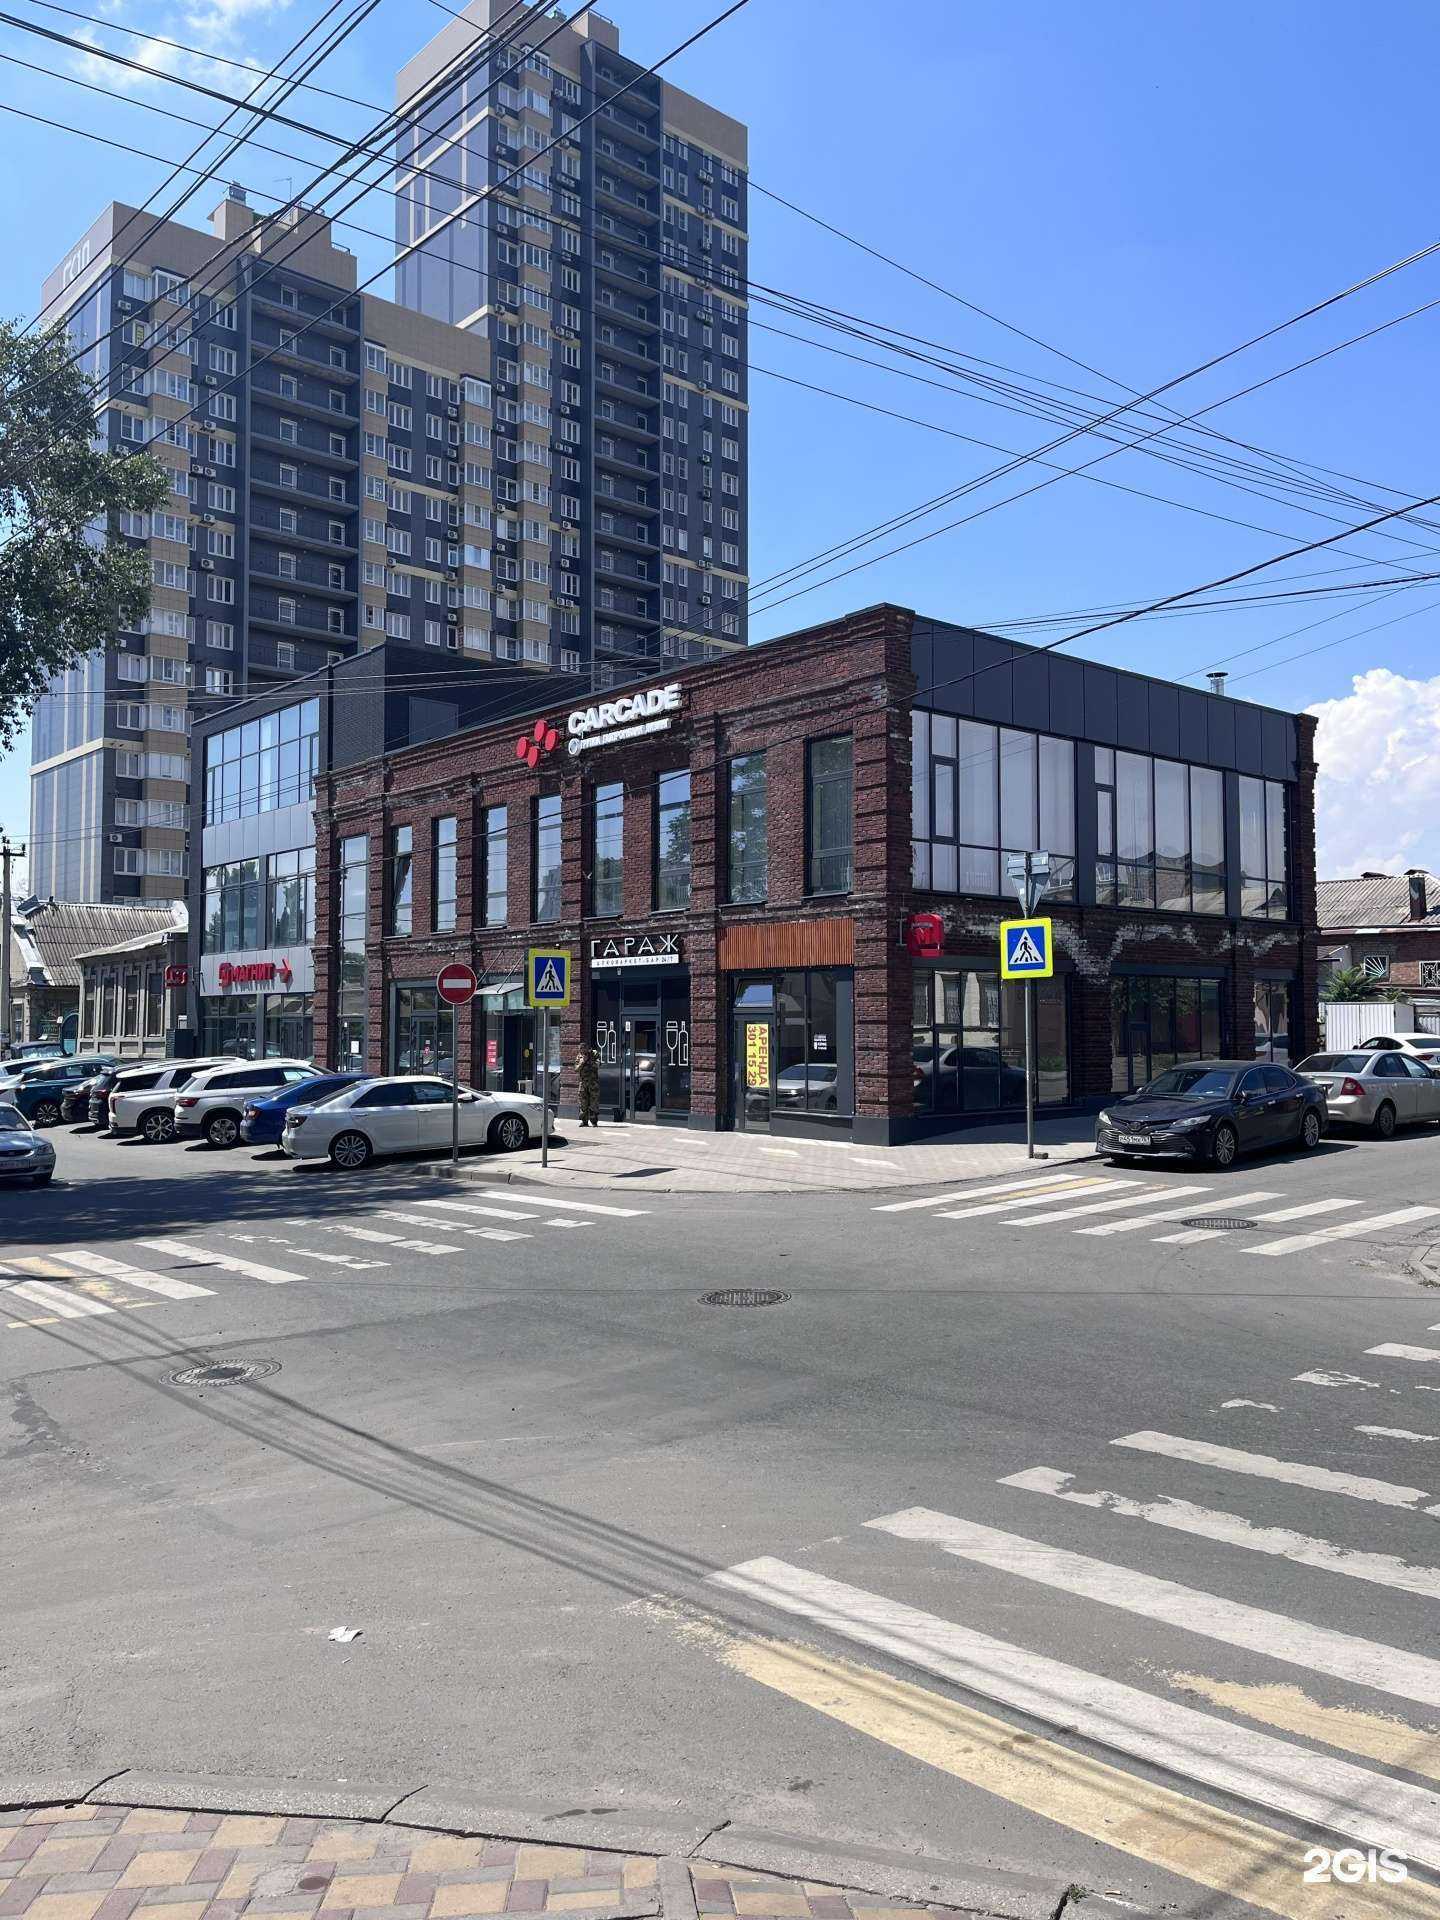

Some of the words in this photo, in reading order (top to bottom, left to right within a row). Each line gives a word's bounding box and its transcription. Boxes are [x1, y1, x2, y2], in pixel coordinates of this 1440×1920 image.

[568, 683, 682, 736] CARCADE
[591, 934, 679, 957] ГАРАЖ
[231, 963, 276, 983] МАГНИТ
[747, 1025, 757, 1047] 301
[747, 1053, 757, 1067] 15
[757, 1025, 768, 1086] АРЕНДА
